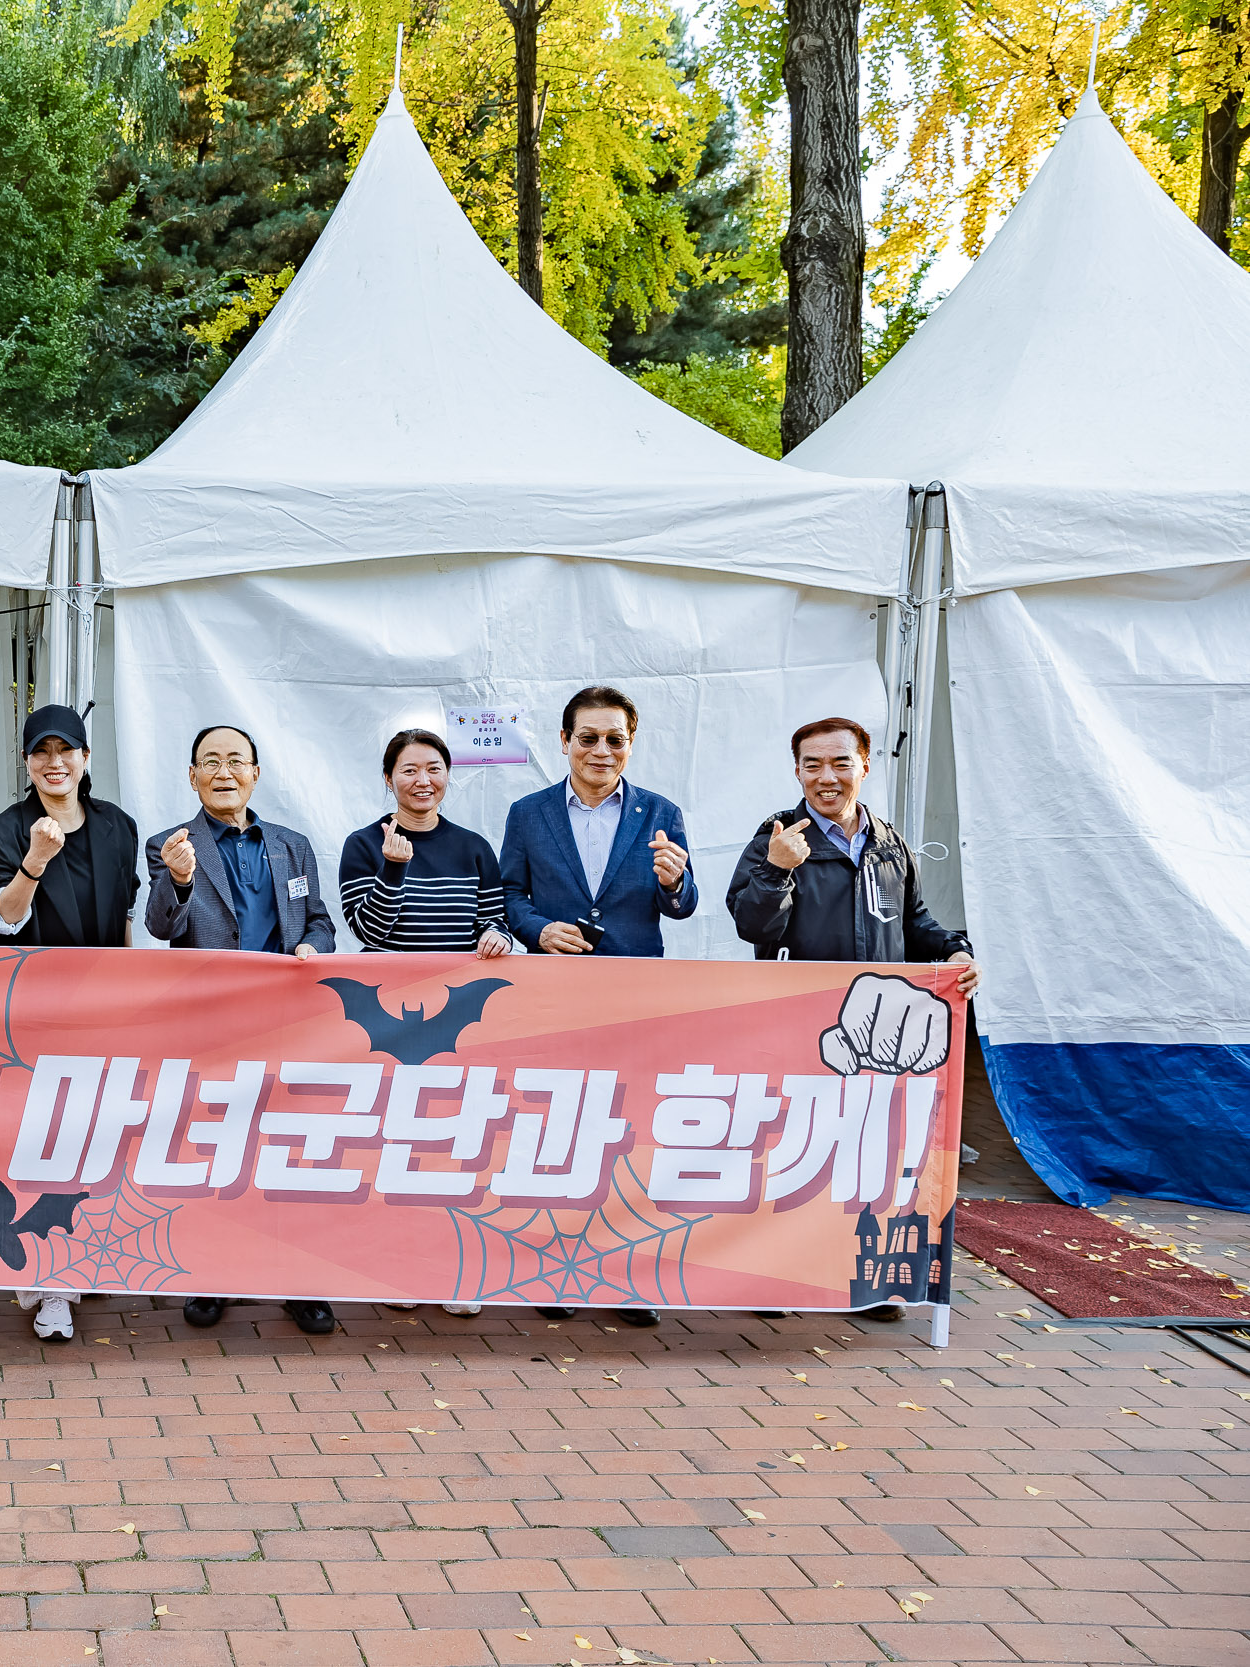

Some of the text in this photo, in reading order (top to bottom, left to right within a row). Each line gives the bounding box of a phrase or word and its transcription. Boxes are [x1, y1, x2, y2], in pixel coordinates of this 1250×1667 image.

[472, 736, 502, 747] 이순임
[6, 1053, 628, 1201] 마녀군단과
[646, 1063, 939, 1208] 함께!
